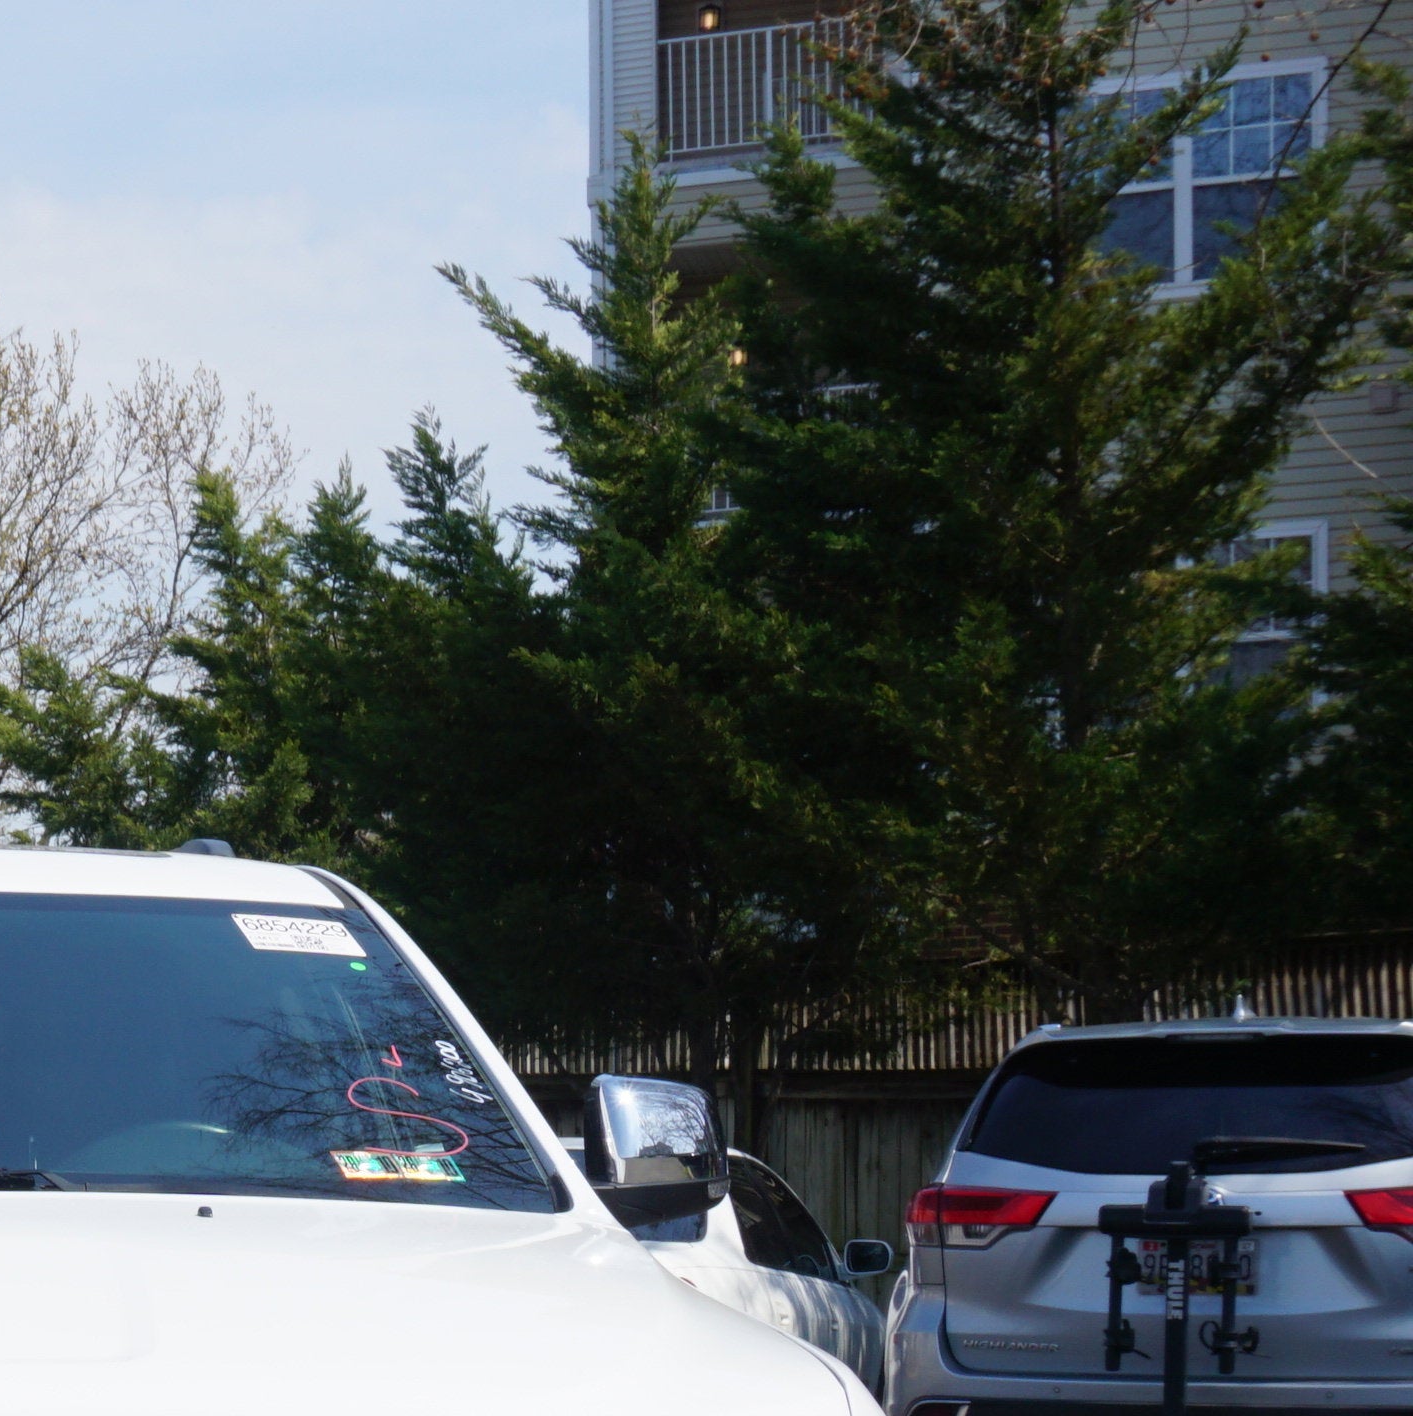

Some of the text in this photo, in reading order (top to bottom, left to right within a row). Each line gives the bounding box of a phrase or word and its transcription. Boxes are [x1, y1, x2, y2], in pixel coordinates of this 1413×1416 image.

[242, 917, 348, 938] 6854229
[1167, 1259, 1185, 1320] THULE
[962, 1339, 1061, 1352] HIGHLANDER
